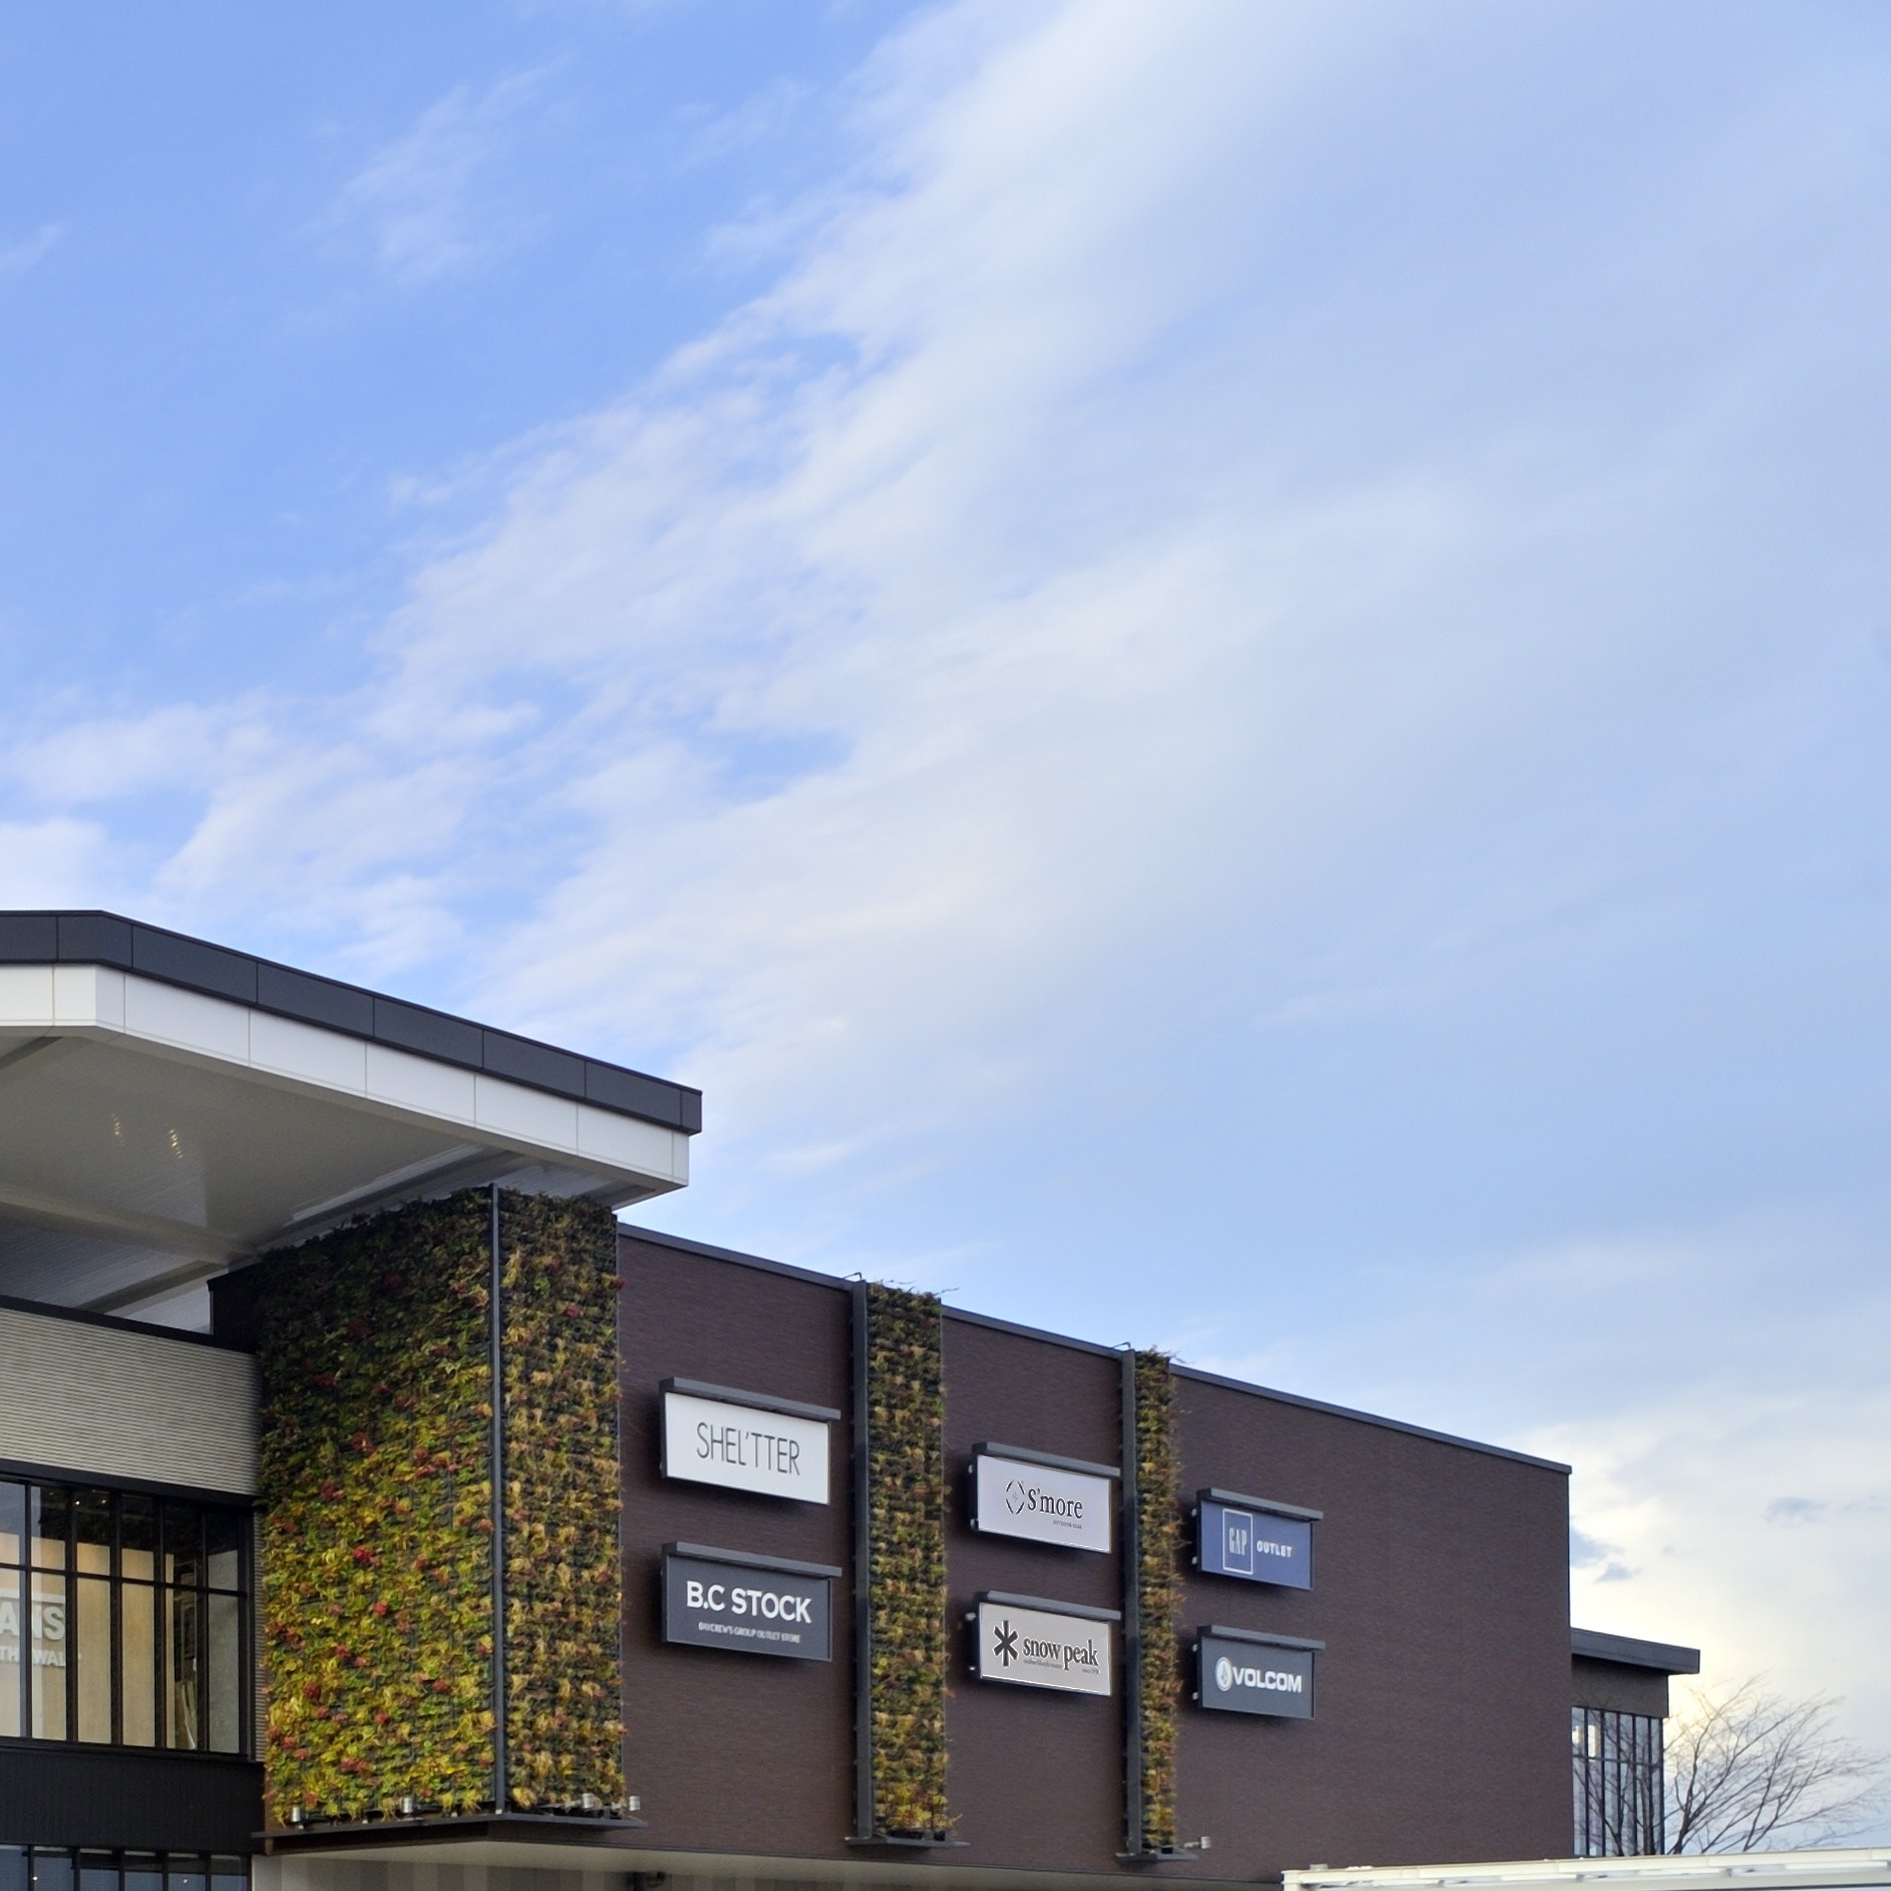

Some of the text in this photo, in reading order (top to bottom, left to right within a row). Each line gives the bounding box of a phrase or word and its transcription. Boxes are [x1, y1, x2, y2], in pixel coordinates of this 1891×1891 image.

[696, 1421, 801, 1477] SHEL'TTER
[1027, 1487, 1084, 1520] S'more
[1228, 1527, 1293, 1558] GAP OUTLET
[686, 1580, 813, 1624] B.C STOCK
[1023, 1638, 1099, 1671] snow peak
[1232, 1666, 1303, 1694] VOLCOM
